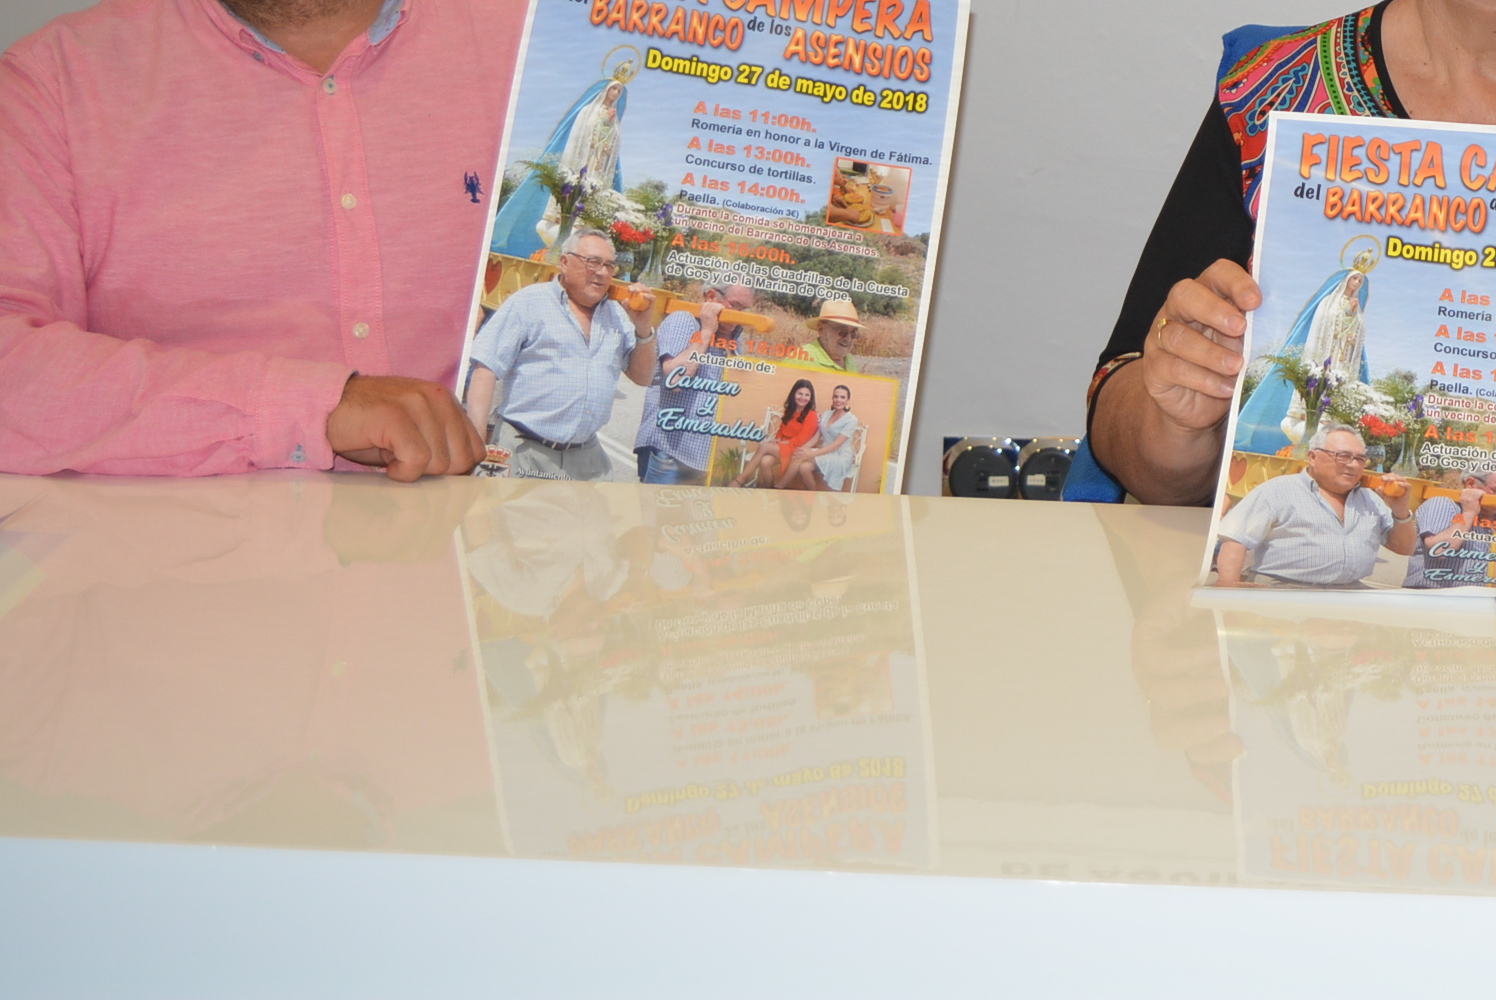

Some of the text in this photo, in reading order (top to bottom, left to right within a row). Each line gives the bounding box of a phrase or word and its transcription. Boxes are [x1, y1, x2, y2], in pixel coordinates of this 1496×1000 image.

[747, 15, 766, 33] de
[769, 19, 792, 38] los
[784, 27, 932, 83] ASENSIOS
[646, 48, 929, 114] Domingo 27 de mayo de 2018
[693, 100, 818, 133] A las 11:00h.
[691, 118, 934, 172] Romería en honor a la Virgen de Fátima.
[1300, 132, 1446, 188] FIESTA
[684, 153, 817, 185] Concurso de tortillas.
[1294, 182, 1321, 201] del
[1323, 185, 1488, 234] BARRANCO
[1387, 237, 1478, 270] Domingo
[1439, 287, 1454, 302] A
[1460, 290, 1491, 307] las
[1435, 324, 1451, 339] A
[1456, 326, 1487, 343] las
[664, 364, 742, 400] Carmen
[1431, 361, 1446, 376] A
[1452, 363, 1483, 380] las
[696, 394, 716, 416] y
[656, 406, 768, 445] Esmeralda
[1424, 424, 1440, 439] A
[1446, 426, 1477, 443] las
[1452, 514, 1466, 525] A
[1466, 561, 1485, 573] y
